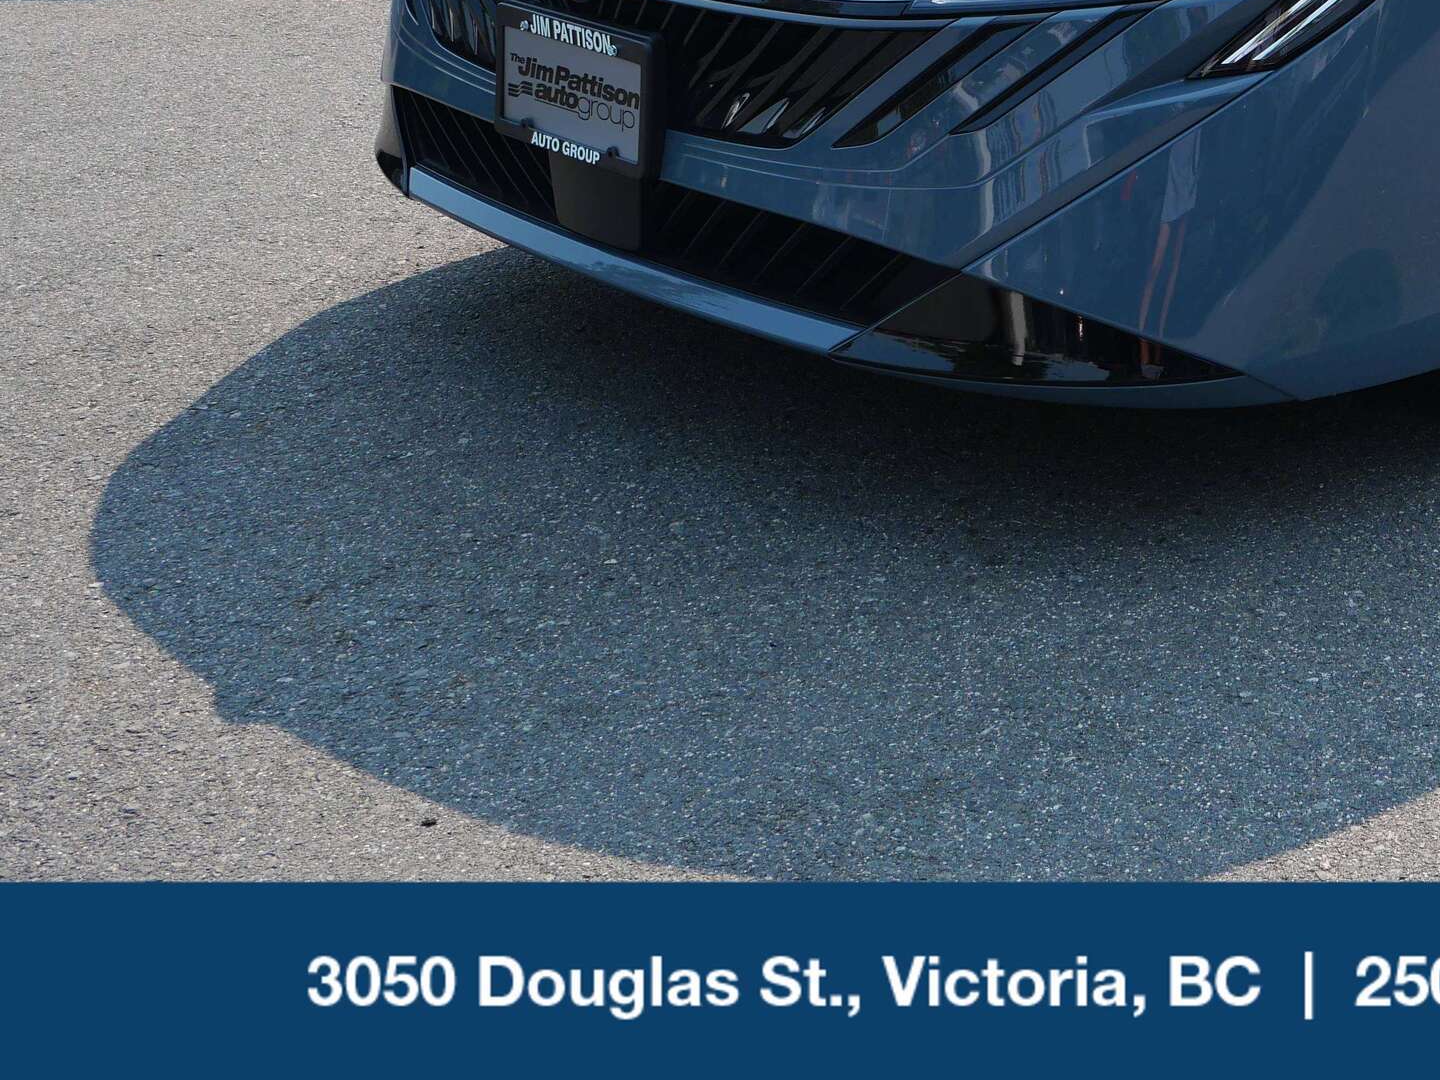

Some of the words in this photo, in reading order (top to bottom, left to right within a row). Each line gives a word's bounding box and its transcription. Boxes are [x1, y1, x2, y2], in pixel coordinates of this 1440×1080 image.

[530, 14, 551, 38] JIM
[552, 20, 611, 55] PATTISON
[531, 131, 560, 152] AUTO
[562, 141, 600, 165] GROUP
